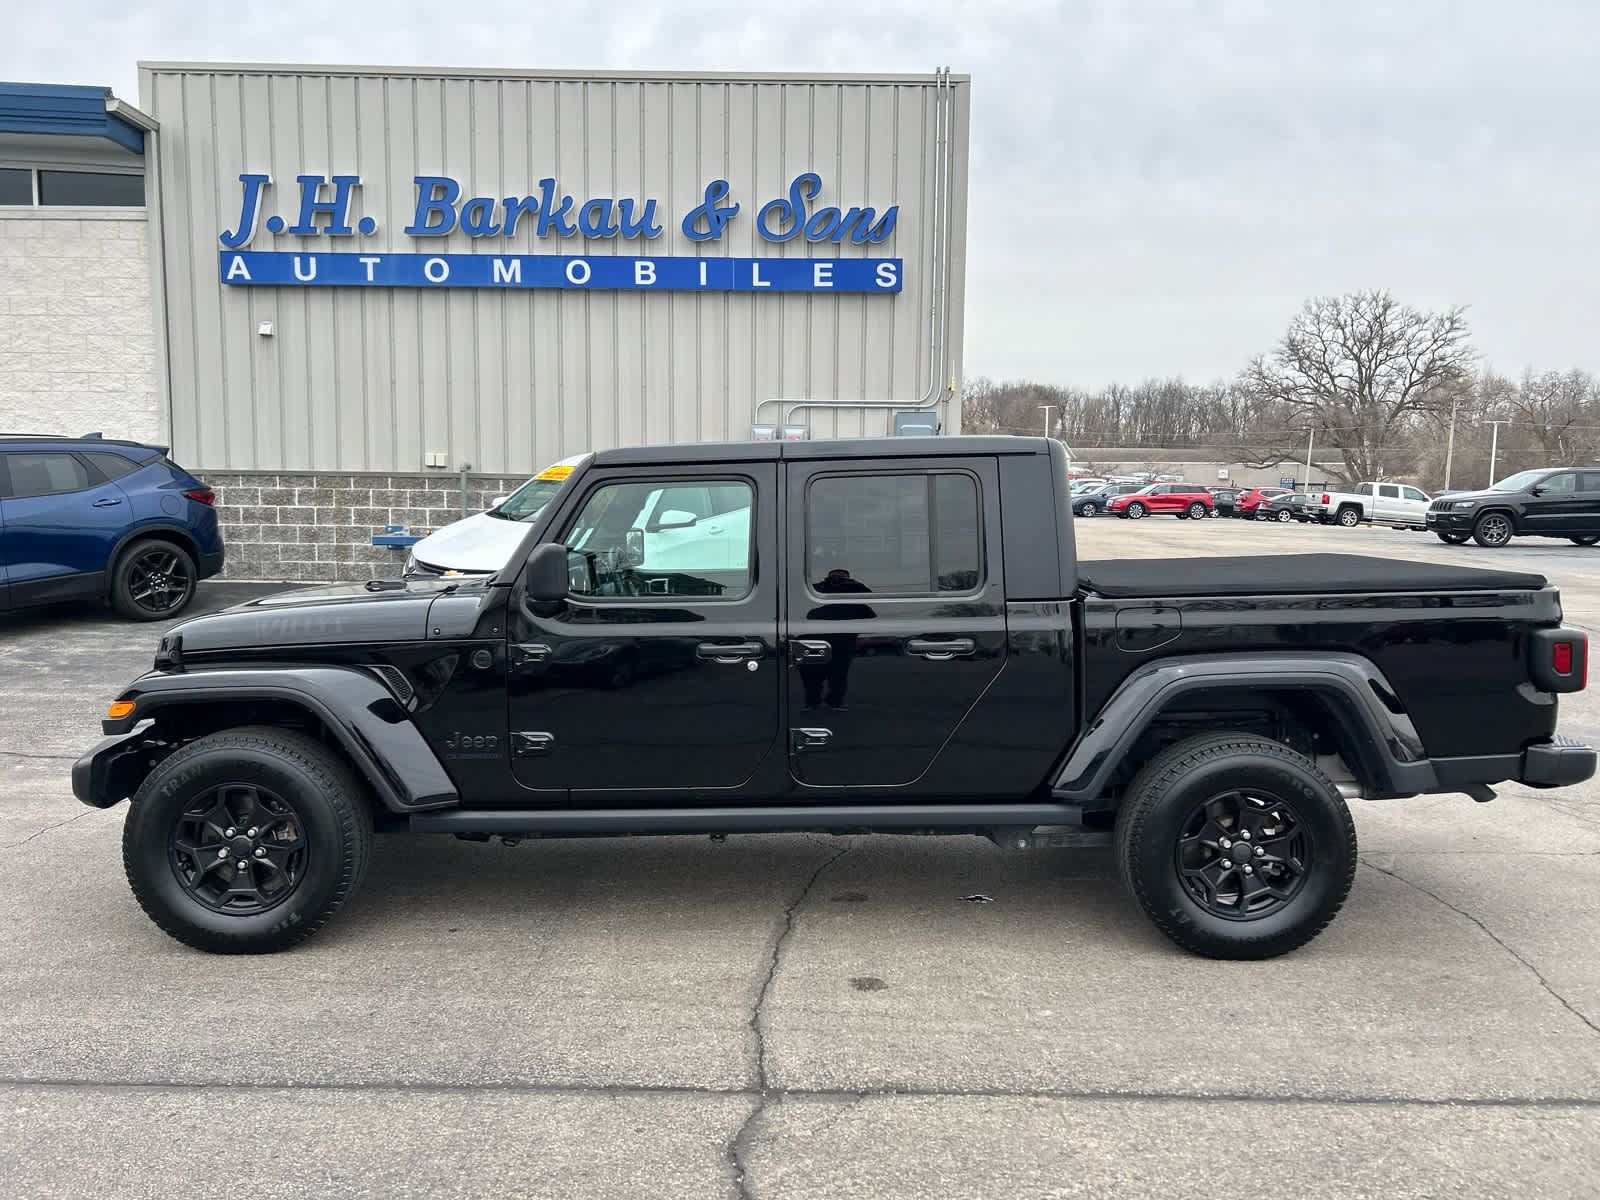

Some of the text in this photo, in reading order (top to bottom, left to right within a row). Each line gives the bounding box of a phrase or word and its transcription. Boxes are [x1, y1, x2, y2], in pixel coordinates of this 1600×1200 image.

[220, 171, 900, 249] J.H. Barkau & Sons
[226, 254, 898, 288] AUTOMOBILES
[445, 731, 498, 751] Jeep
